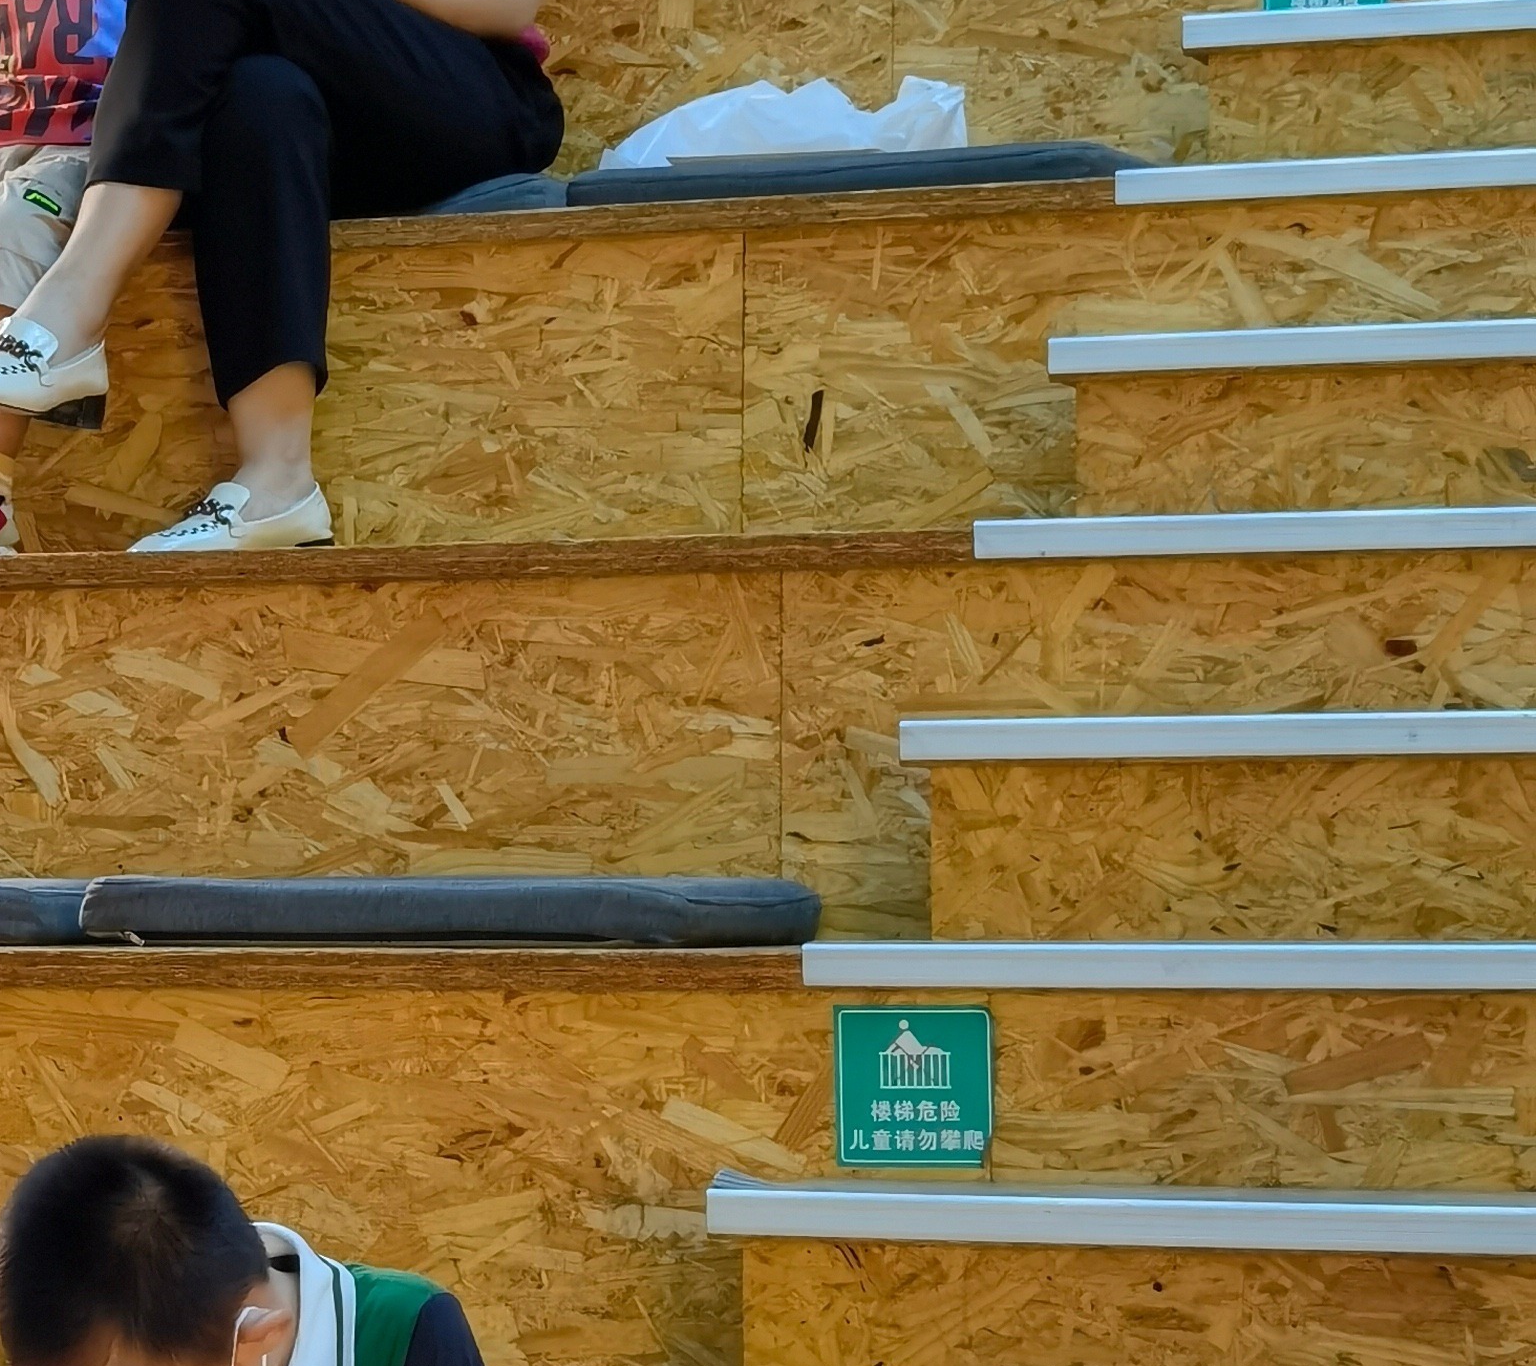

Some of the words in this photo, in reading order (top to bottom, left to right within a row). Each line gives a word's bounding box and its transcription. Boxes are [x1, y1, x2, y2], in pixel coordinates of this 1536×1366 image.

[870, 1099, 961, 1123] 楼梯危险
[849, 1129, 985, 1152] 儿童请勿攀爬
